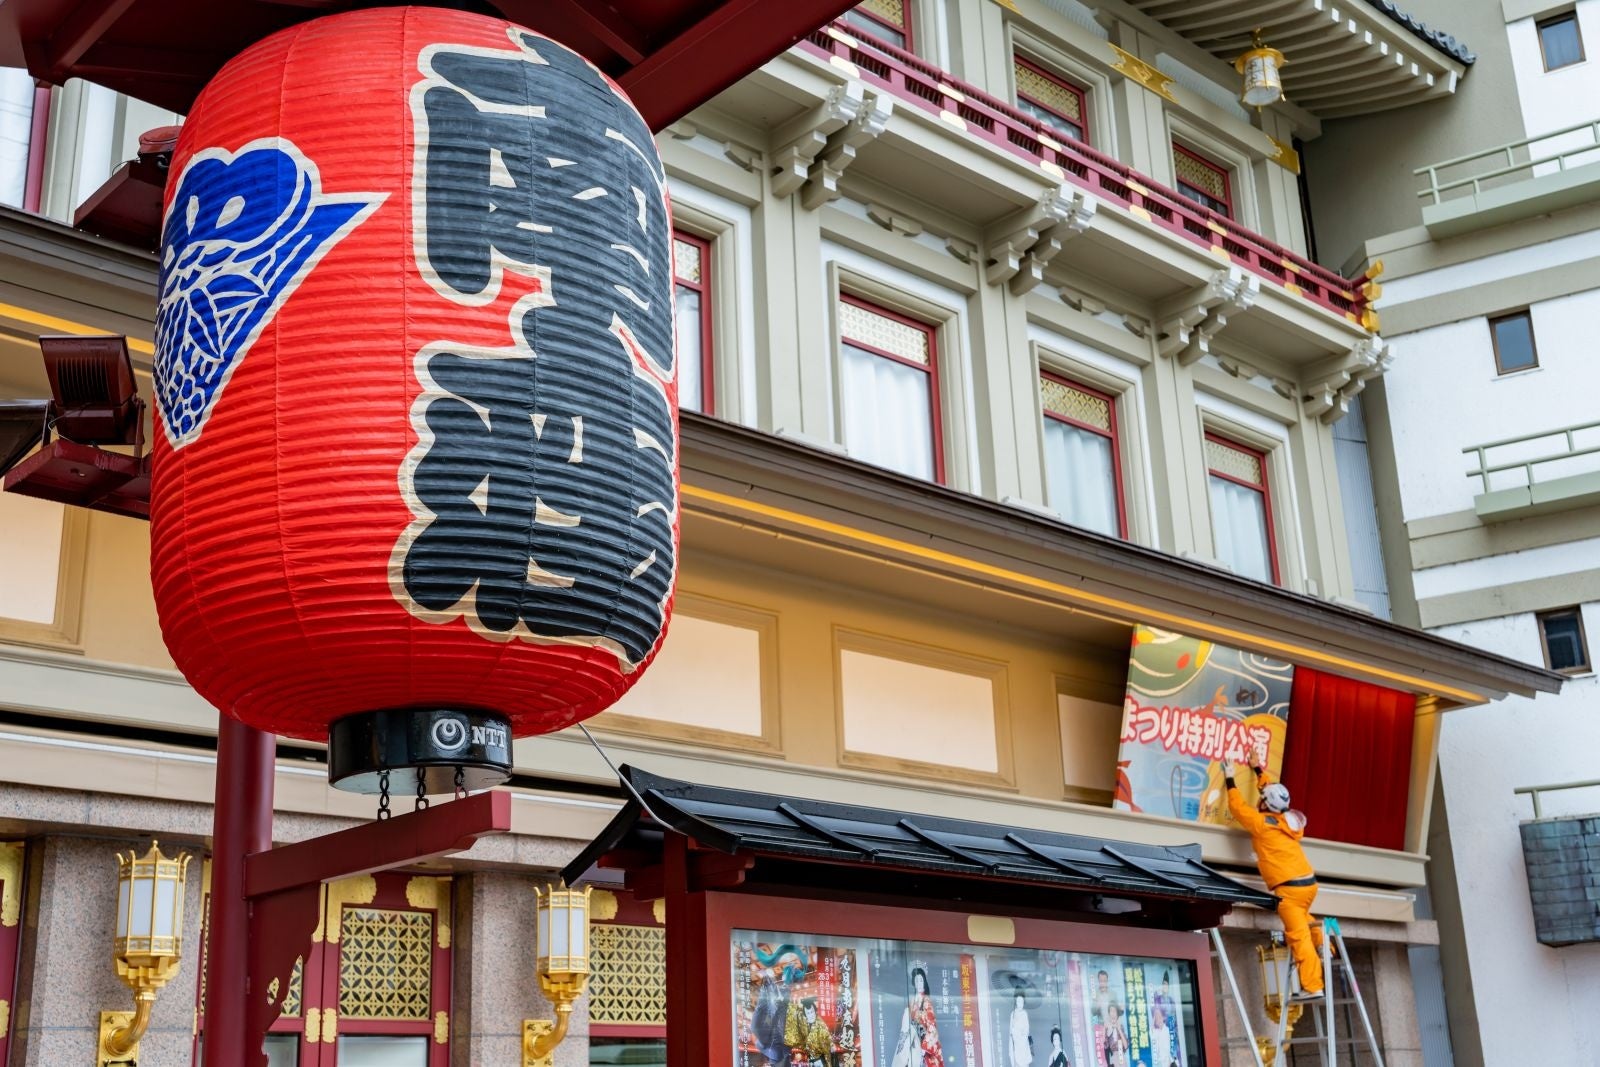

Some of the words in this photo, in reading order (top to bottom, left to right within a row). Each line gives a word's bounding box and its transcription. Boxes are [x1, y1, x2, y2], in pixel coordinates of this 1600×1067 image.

[471, 725, 507, 749] NTT
[1120, 697, 1271, 768] まつり特別公演
